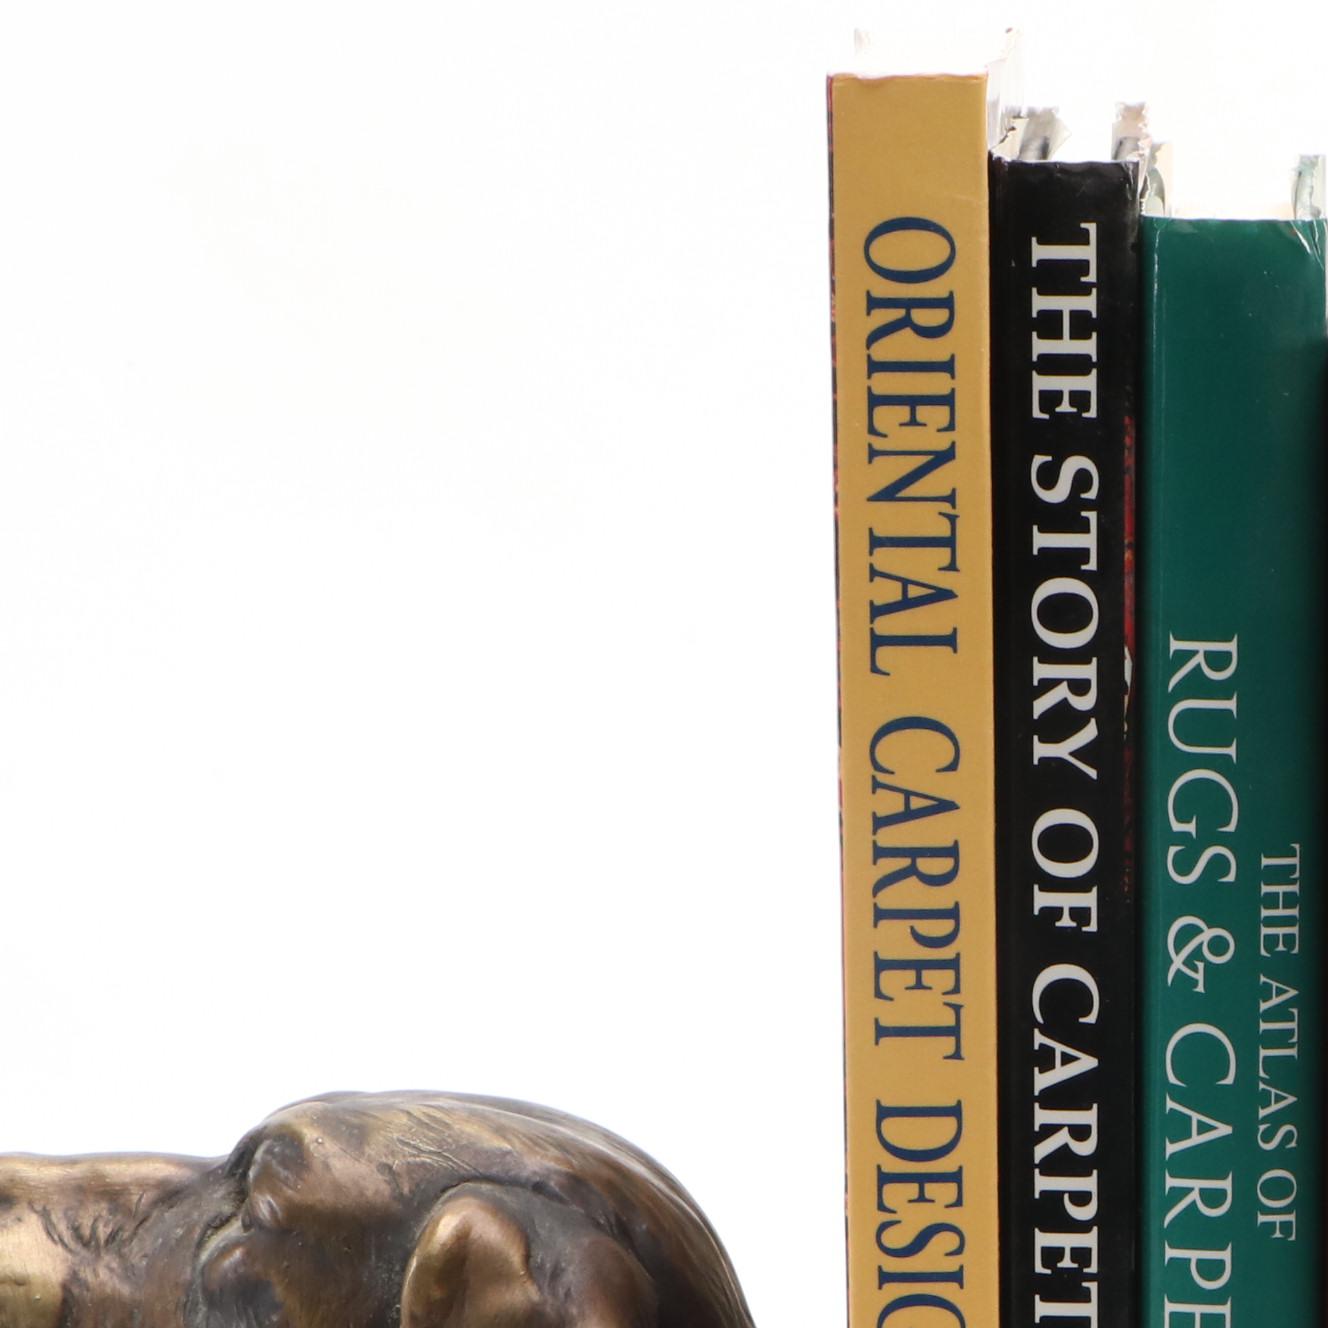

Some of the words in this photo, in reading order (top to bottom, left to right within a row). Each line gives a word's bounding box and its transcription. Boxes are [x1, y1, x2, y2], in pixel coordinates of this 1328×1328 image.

[1031, 222, 1097, 420] THE
[864, 216, 959, 676] ORIENTAL
[1031, 455, 1100, 780] STORY
[1167, 633, 1239, 885] RUGS
[868, 716, 965, 1061] CARPET
[1031, 808, 1099, 932] OF
[1260, 843, 1300, 958] THE
[1258, 973, 1300, 1151] ATLAS
[1256, 1168, 1297, 1241] OF
